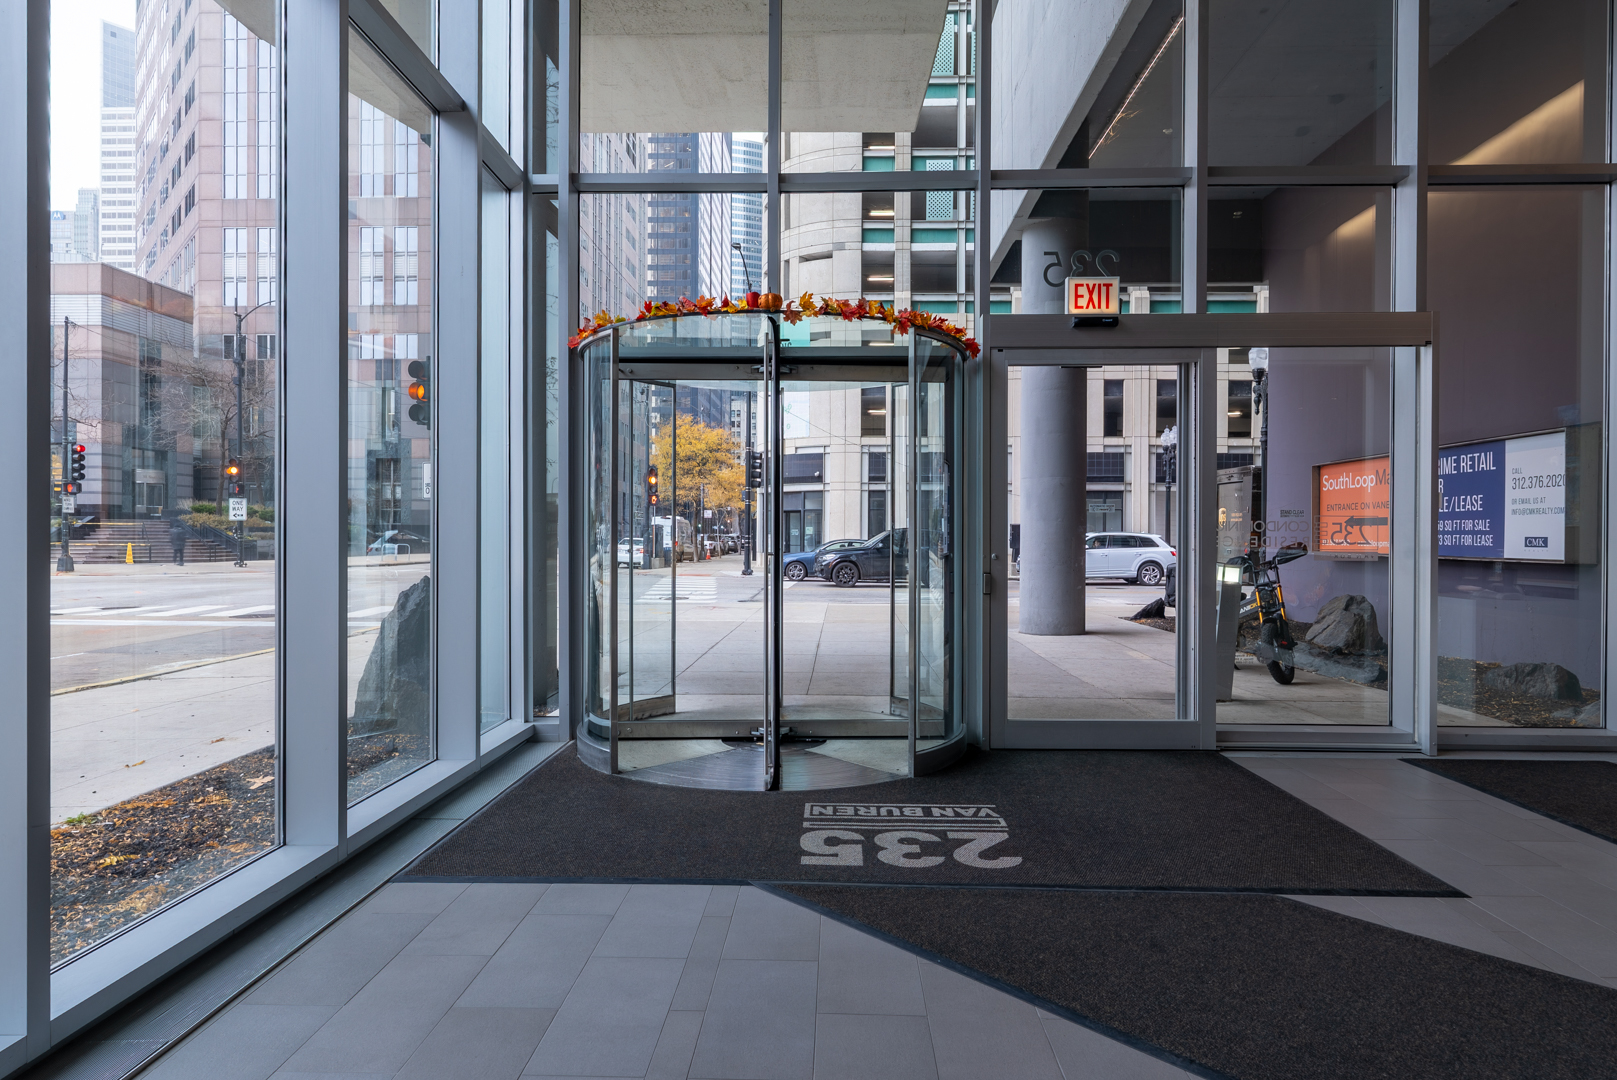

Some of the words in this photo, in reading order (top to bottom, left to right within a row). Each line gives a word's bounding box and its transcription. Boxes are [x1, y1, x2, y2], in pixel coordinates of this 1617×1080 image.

[1074, 283, 1113, 309] EXIT
[1461, 451, 1496, 473] RETAIL
[1326, 502, 1359, 512] ENTRANCE
[1360, 502, 1370, 510] ON
[1438, 495, 1483, 512] E/LEASE
[1511, 507, 1565, 516] INFO@CMKREALTY.COM
[1444, 520, 1452, 531] SQ
[1453, 520, 1461, 530] FT
[1462, 519, 1473, 530] FOR
[1474, 519, 1490, 530] SALE
[1444, 534, 1451, 546] SQ
[1453, 534, 1460, 546] FT
[1461, 534, 1473, 546] FOR
[1474, 534, 1494, 546] LEASE
[1526, 538, 1545, 547] CMK
[812, 805, 924, 817] BUREN
[931, 806, 1001, 818] VAN
[800, 829, 1023, 869] 235
